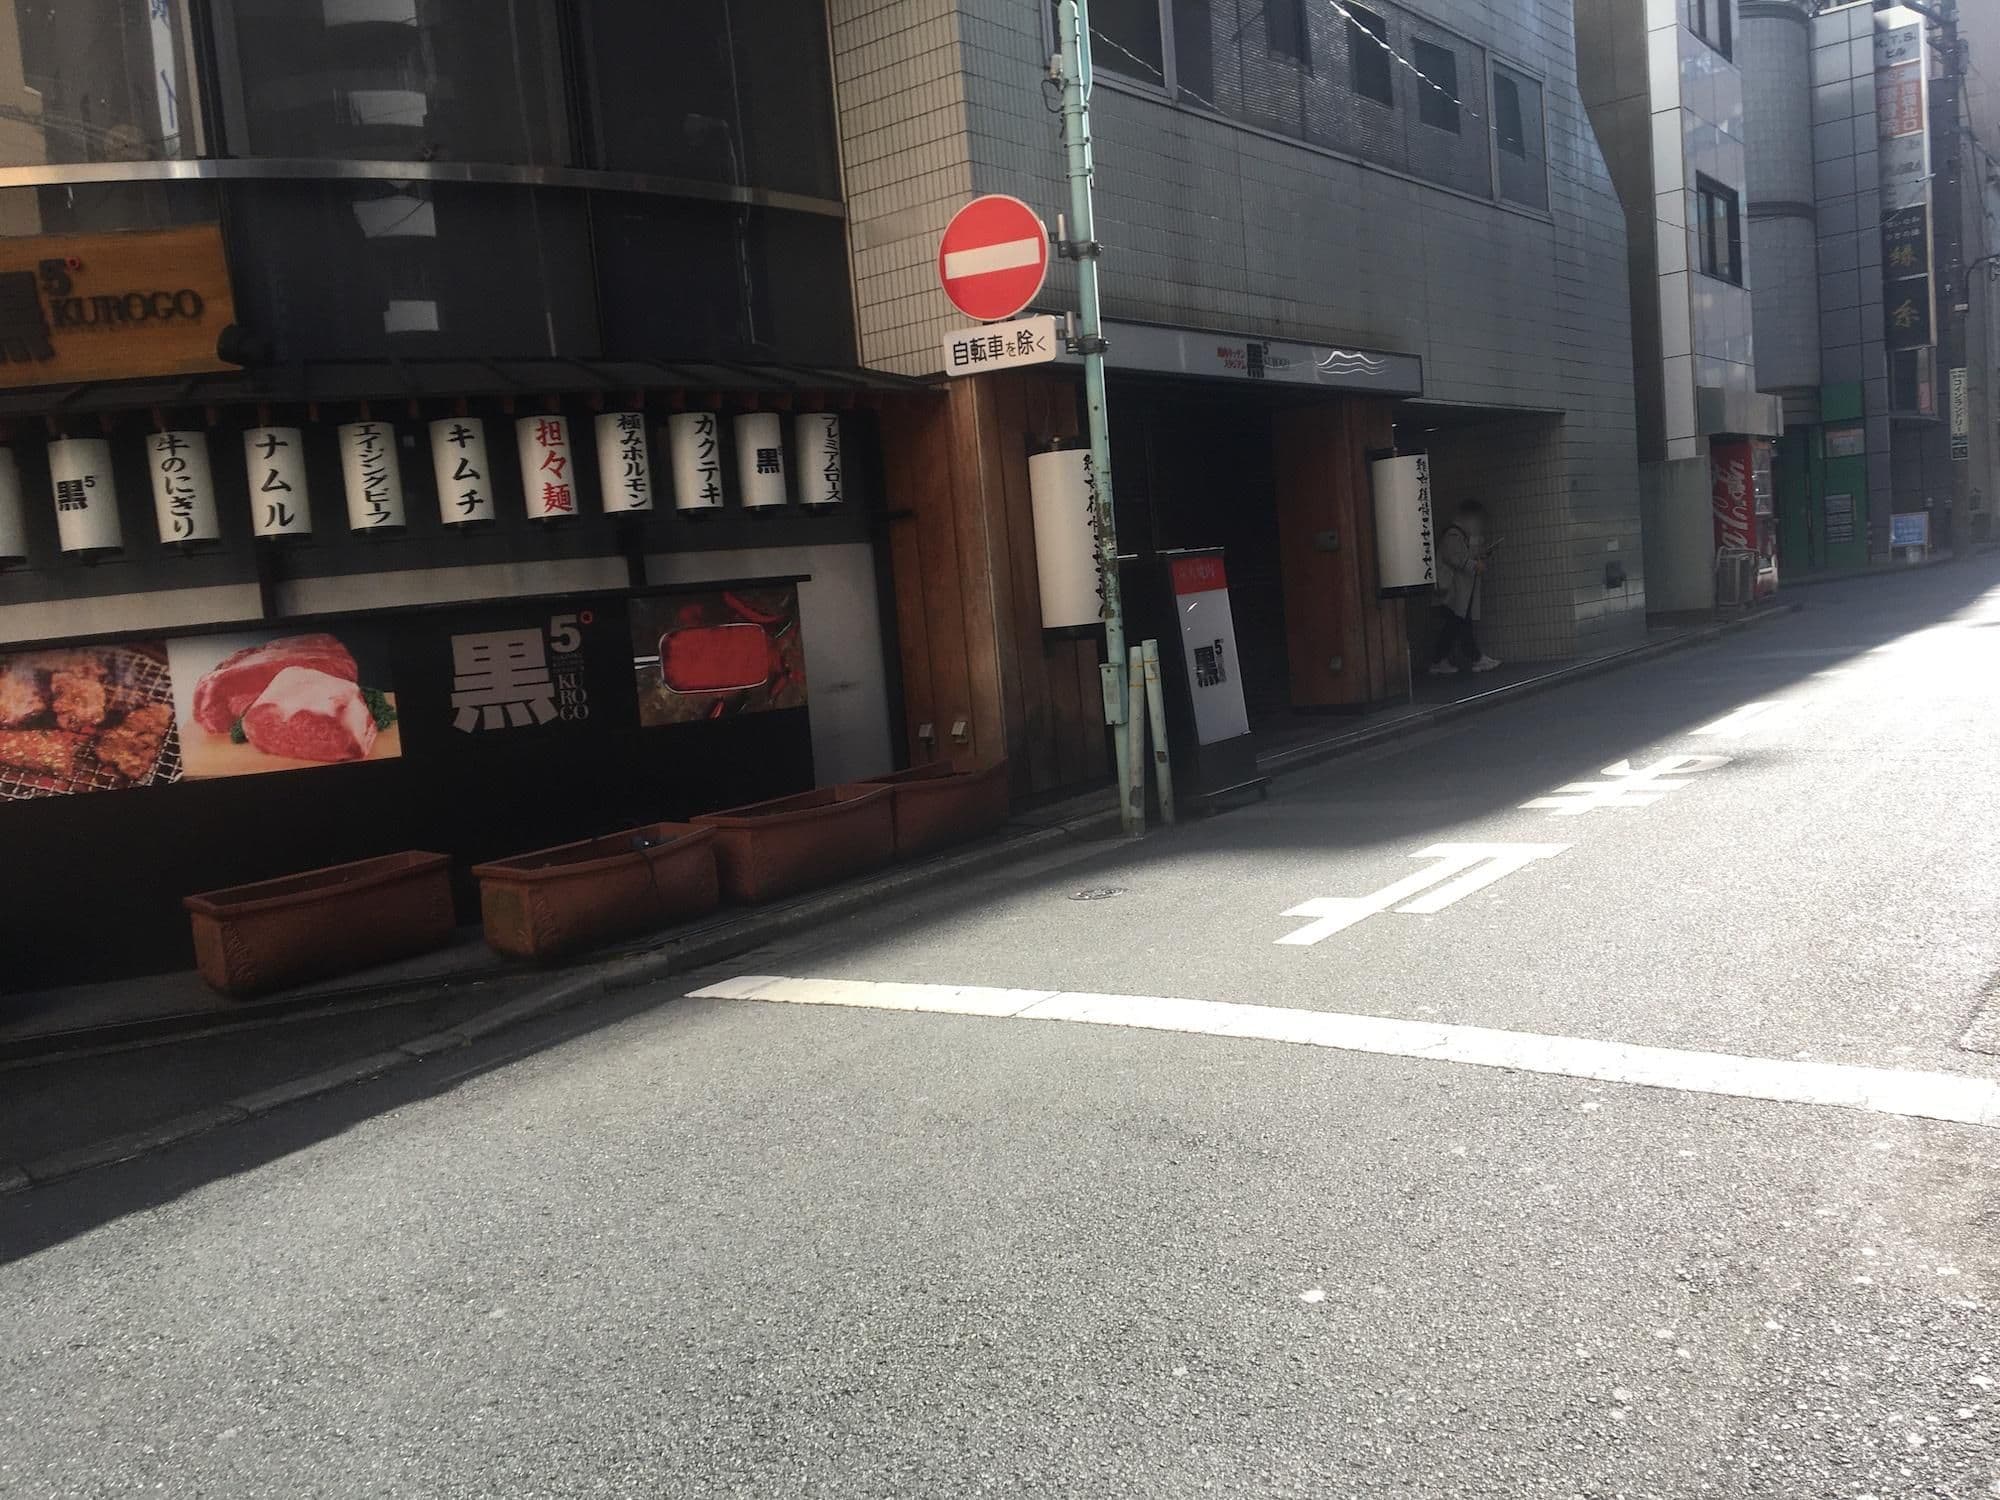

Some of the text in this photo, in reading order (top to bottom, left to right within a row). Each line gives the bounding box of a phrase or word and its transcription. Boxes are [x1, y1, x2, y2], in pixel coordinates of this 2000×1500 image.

[52, 288, 205, 328] KUROGO
[953, 329, 1047, 366] 自転車を除く
[157, 434, 196, 538] 牛のにぎり
[256, 433, 295, 528] ナムル
[354, 424, 391, 525] エイジングビーフ
[447, 424, 484, 515] キムチ
[536, 418, 573, 513] 担々麺
[617, 414, 648, 508] 極みホルモン
[694, 414, 720, 504] カクテキ
[757, 448, 780, 474] 黒
[451, 628, 559, 734] 黒
